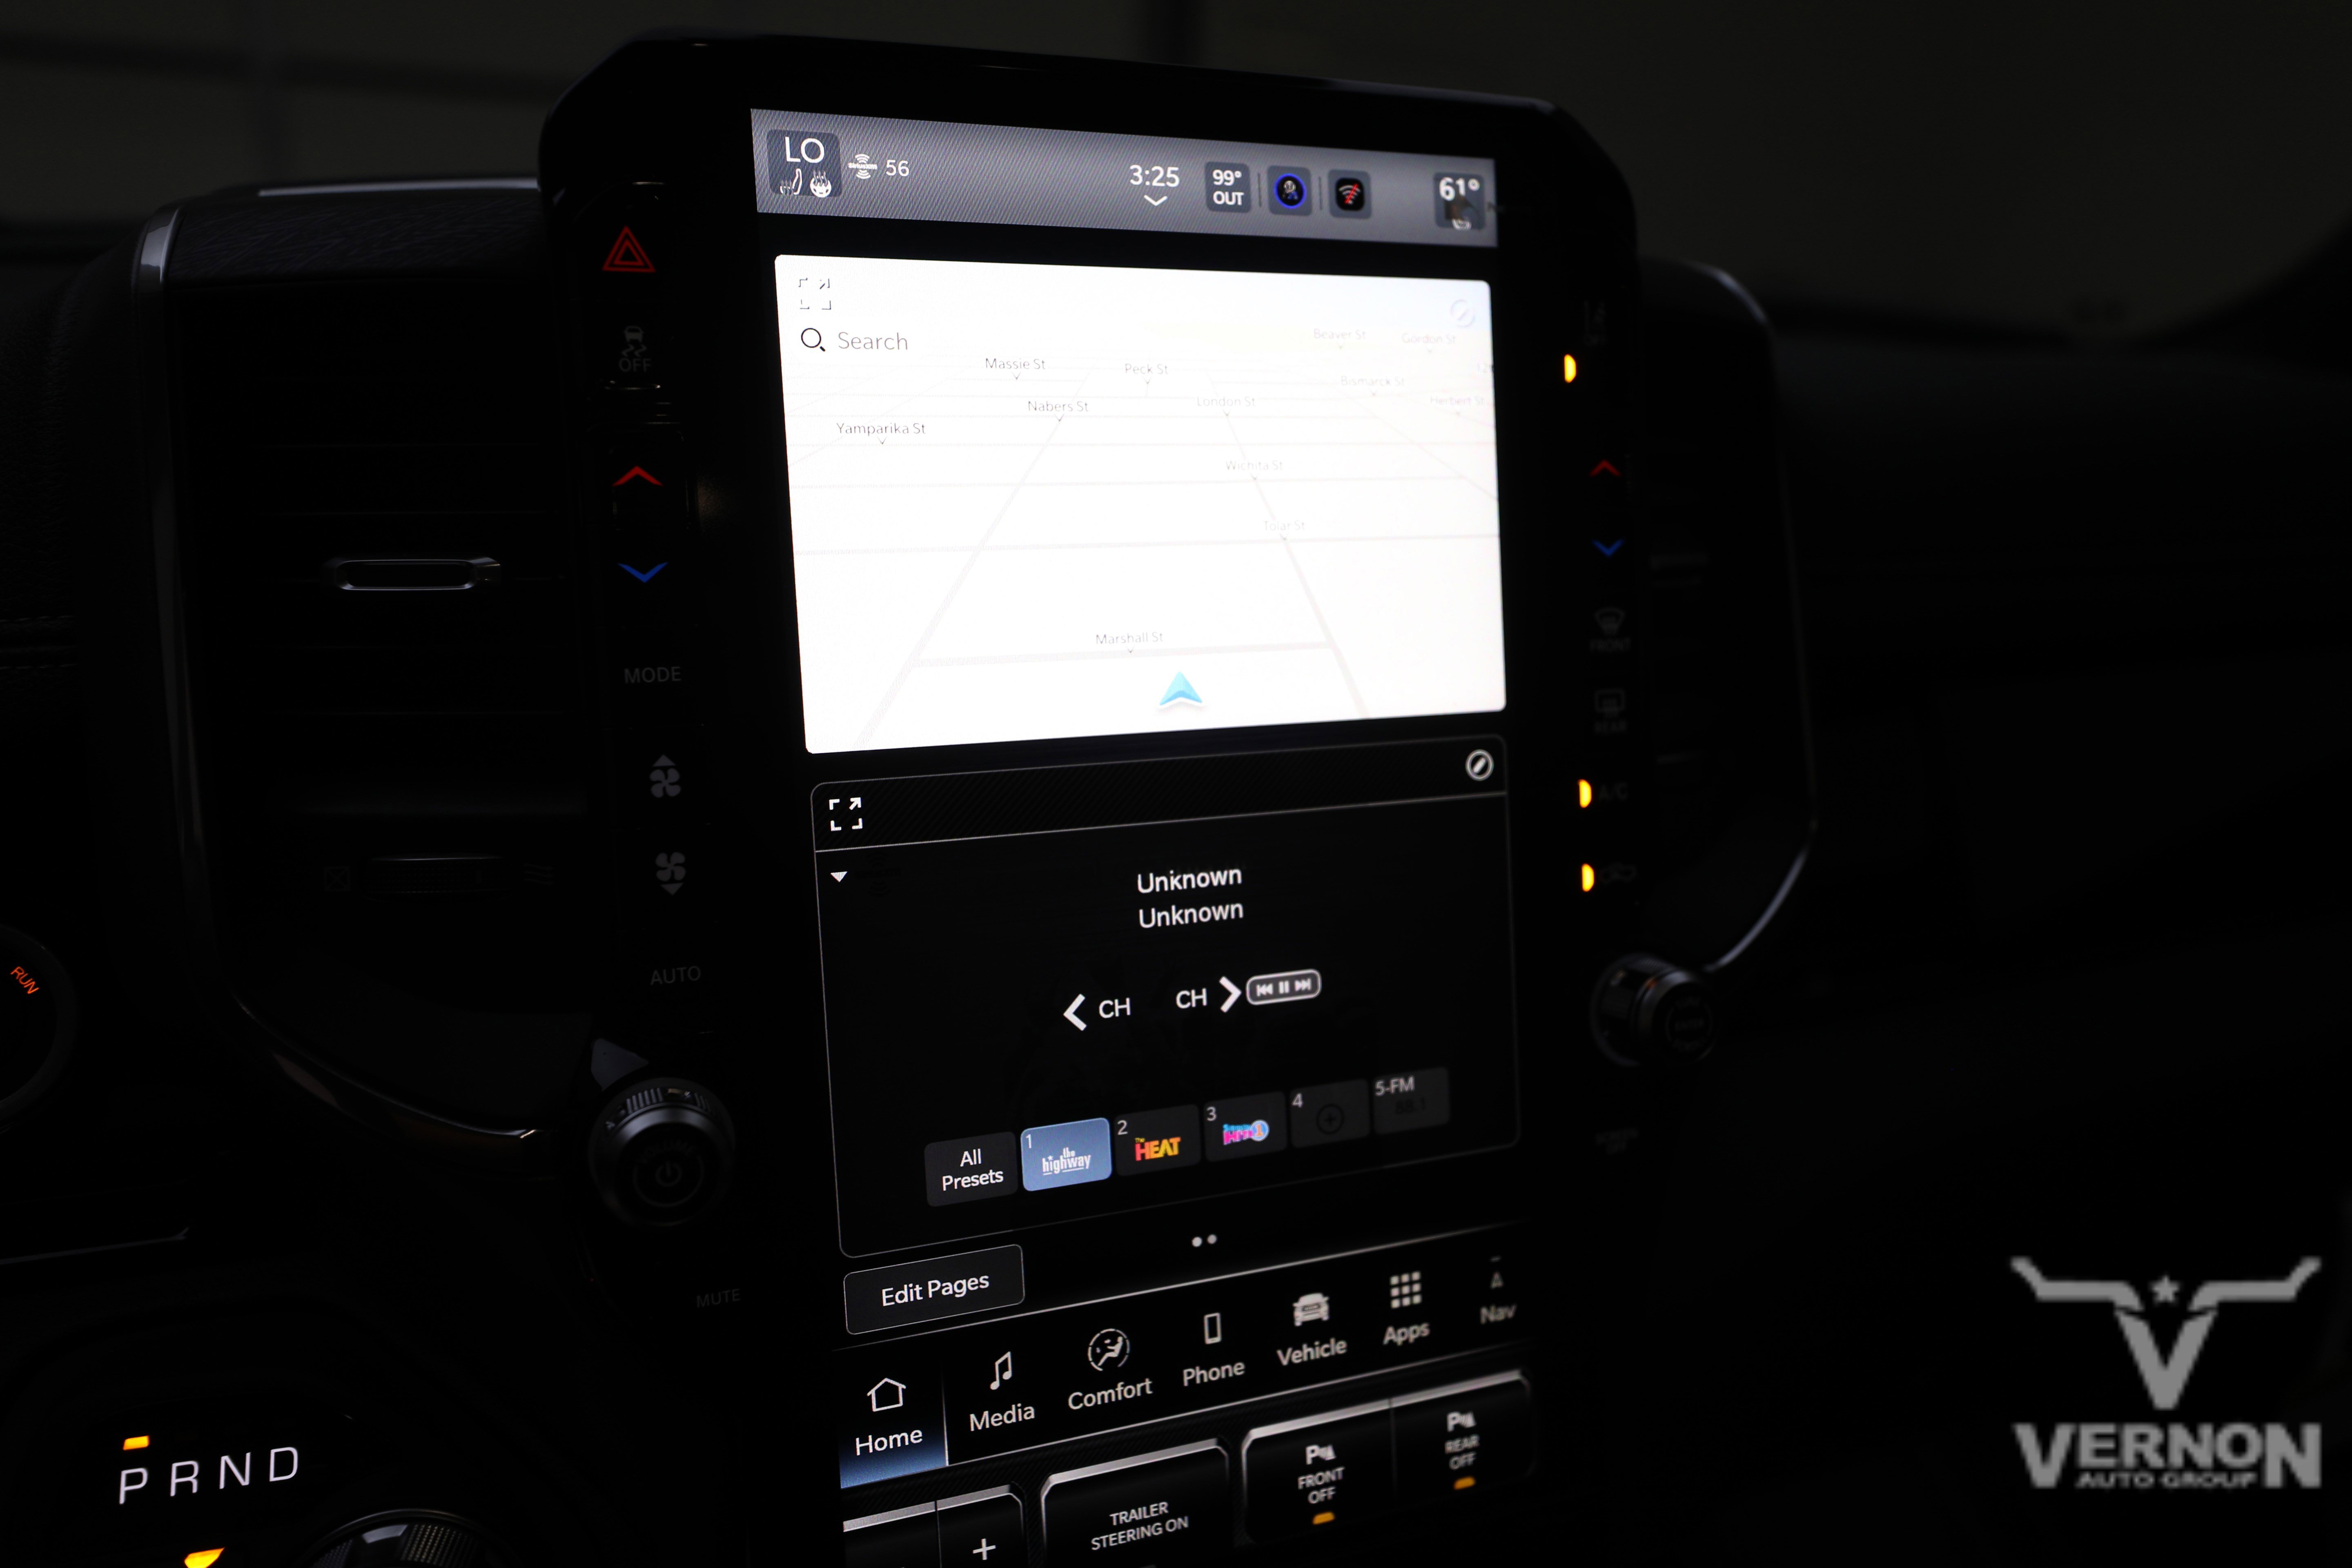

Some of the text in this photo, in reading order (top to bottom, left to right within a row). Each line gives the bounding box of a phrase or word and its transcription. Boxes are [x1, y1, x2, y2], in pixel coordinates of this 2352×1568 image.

[785, 136, 825, 163] LO
[886, 160, 909, 176] 56
[1129, 164, 1180, 187] 3:25
[1212, 169, 1242, 186] 99°
[1213, 191, 1244, 206] OUT
[1439, 177, 1480, 201] 61°
[838, 332, 908, 350] Search
[1355, 329, 1367, 340] St
[618, 358, 653, 372] OFF
[985, 358, 1045, 370] Massie St
[1125, 363, 1169, 375] Peck St
[1394, 376, 1405, 387] St
[1028, 401, 1089, 412] Nabers St
[1197, 396, 1256, 407] London St
[836, 423, 926, 437] Yamparika St
[1225, 460, 1283, 472] Wichita St
[1263, 520, 1306, 531] Tolar St
[1096, 632, 1163, 645] Marshall St
[1589, 637, 1632, 653] FRONT
[624, 666, 682, 684] MODE
[1593, 720, 1628, 735] REAR
[1598, 780, 1629, 802] A/C
[1137, 868, 1242, 893] Unknown
[1138, 902, 1244, 929] Unknown
[10, 965, 40, 995] RUN
[650, 964, 702, 986] AUTO
[1098, 997, 1131, 1019] CH
[1176, 988, 1208, 1009] CH
[1374, 1075, 1415, 1097] 5-FM
[1292, 1093, 1303, 1108] 4
[1207, 1106, 1217, 1122] 3
[1117, 1120, 1128, 1135] 2
[1025, 1134, 1033, 1149] 1
[1135, 1136, 1181, 1161] HEAT
[960, 1148, 982, 1167] All
[1062, 1147, 1076, 1158] the
[1042, 1155, 1091, 1174] highway
[942, 1169, 1004, 1191] Presets
[696, 1288, 742, 1309] MUTE
[881, 1274, 990, 1307] Edit Pages
[1480, 1304, 1517, 1325] Nav
[1383, 1322, 1430, 1346] Apps
[1277, 1338, 1347, 1366] Vehicle
[1183, 1361, 1245, 1387] Phone
[1067, 1378, 1153, 1410] Comfort
[969, 1403, 1035, 1432] Media
[855, 1428, 923, 1456] Home
[1444, 1434, 1481, 1454] REAR
[1449, 1451, 1477, 1471] OFF
[1297, 1466, 1345, 1491] FRONT
[1307, 1487, 1337, 1505] OFF
[1109, 1501, 1169, 1526] TRAILER
[1091, 1515, 1189, 1551] STEERING ON
